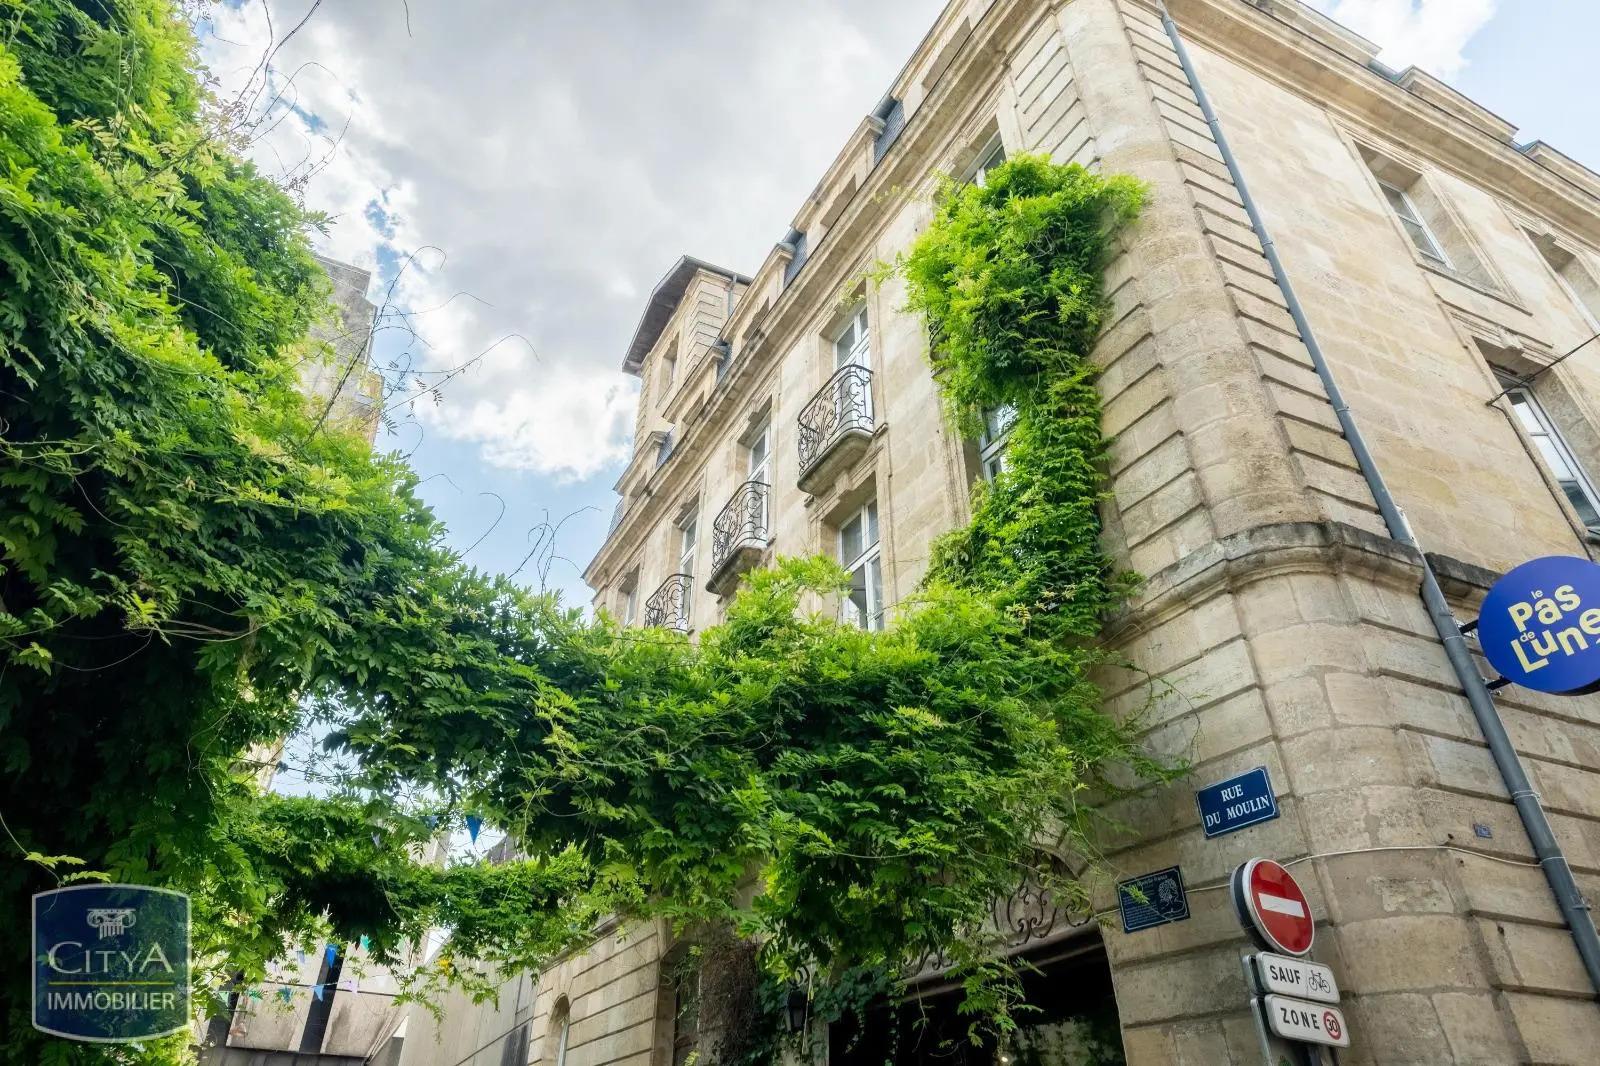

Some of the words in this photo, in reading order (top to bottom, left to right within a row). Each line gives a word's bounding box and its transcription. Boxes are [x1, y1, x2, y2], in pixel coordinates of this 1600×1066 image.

[1531, 590, 1543, 599] le
[1508, 585, 1580, 632] Pas
[1510, 608, 1600, 673] Lune
[1520, 632, 1535, 642] de
[1221, 785, 1243, 802] RUE
[1206, 812, 1221, 827] DU
[1226, 795, 1270, 820] MOULIN
[1269, 965, 1301, 984] SAUF
[1280, 1007, 1320, 1030] ZONE
[1327, 1018, 1340, 1033] 30
